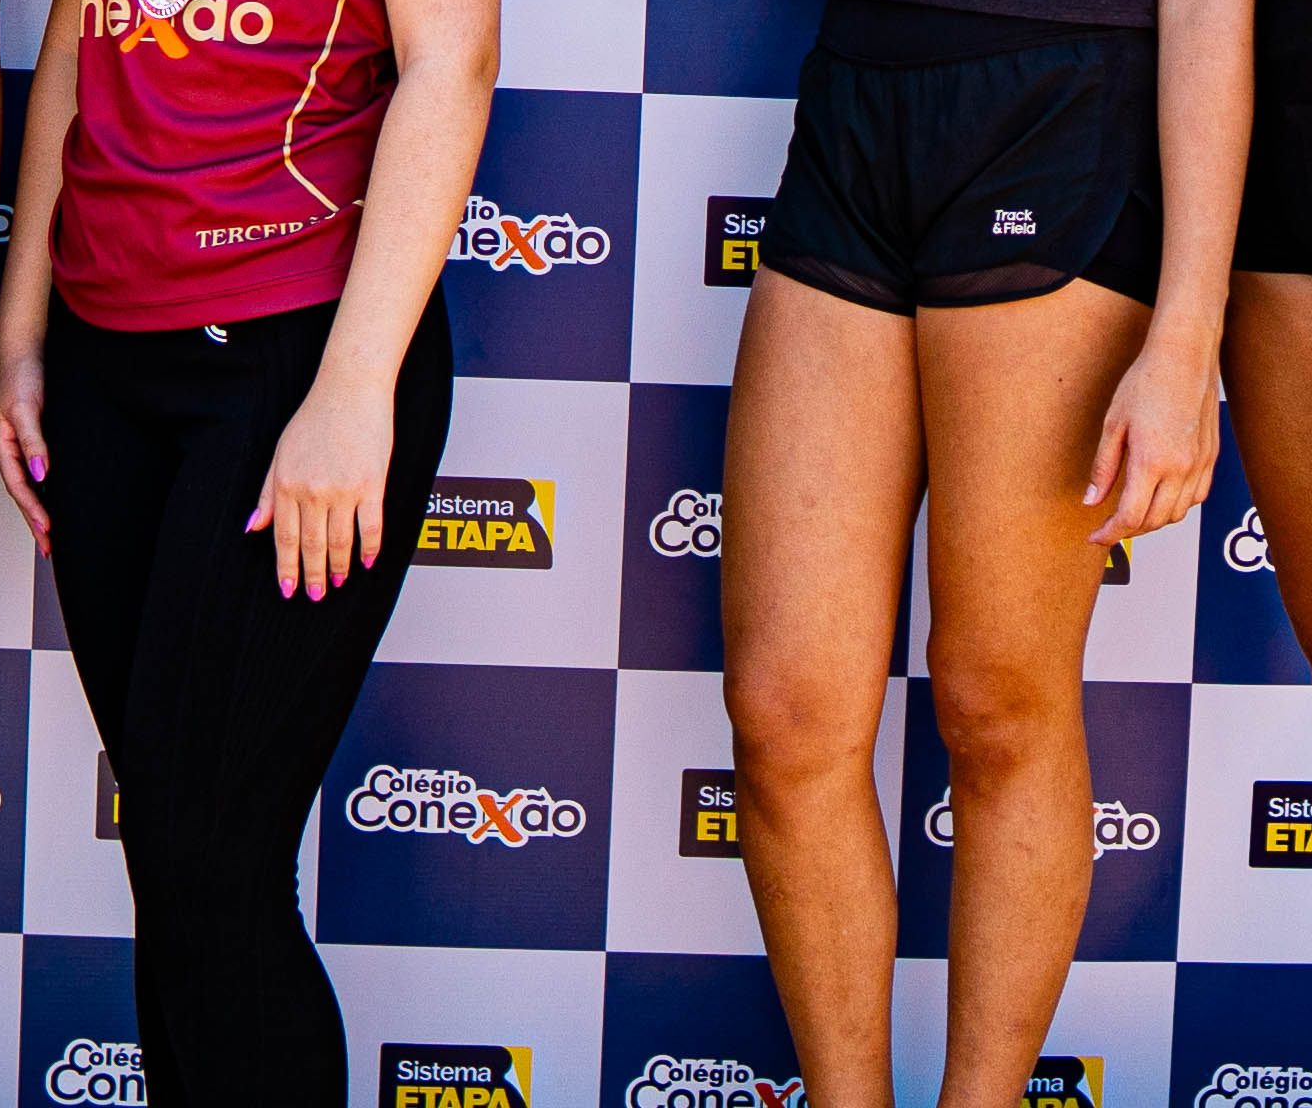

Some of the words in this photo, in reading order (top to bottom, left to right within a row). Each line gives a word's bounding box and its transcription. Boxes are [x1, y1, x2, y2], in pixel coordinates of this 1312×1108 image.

[992, 222, 1003, 234] &
[1004, 222, 1036, 235] Field
[994, 209, 1033, 222] Track
[417, 519, 536, 553] ETAPA
[369, 769, 472, 798] Colégio
[397, 1060, 492, 1083] Sistema
[649, 1059, 750, 1088] Colégio
